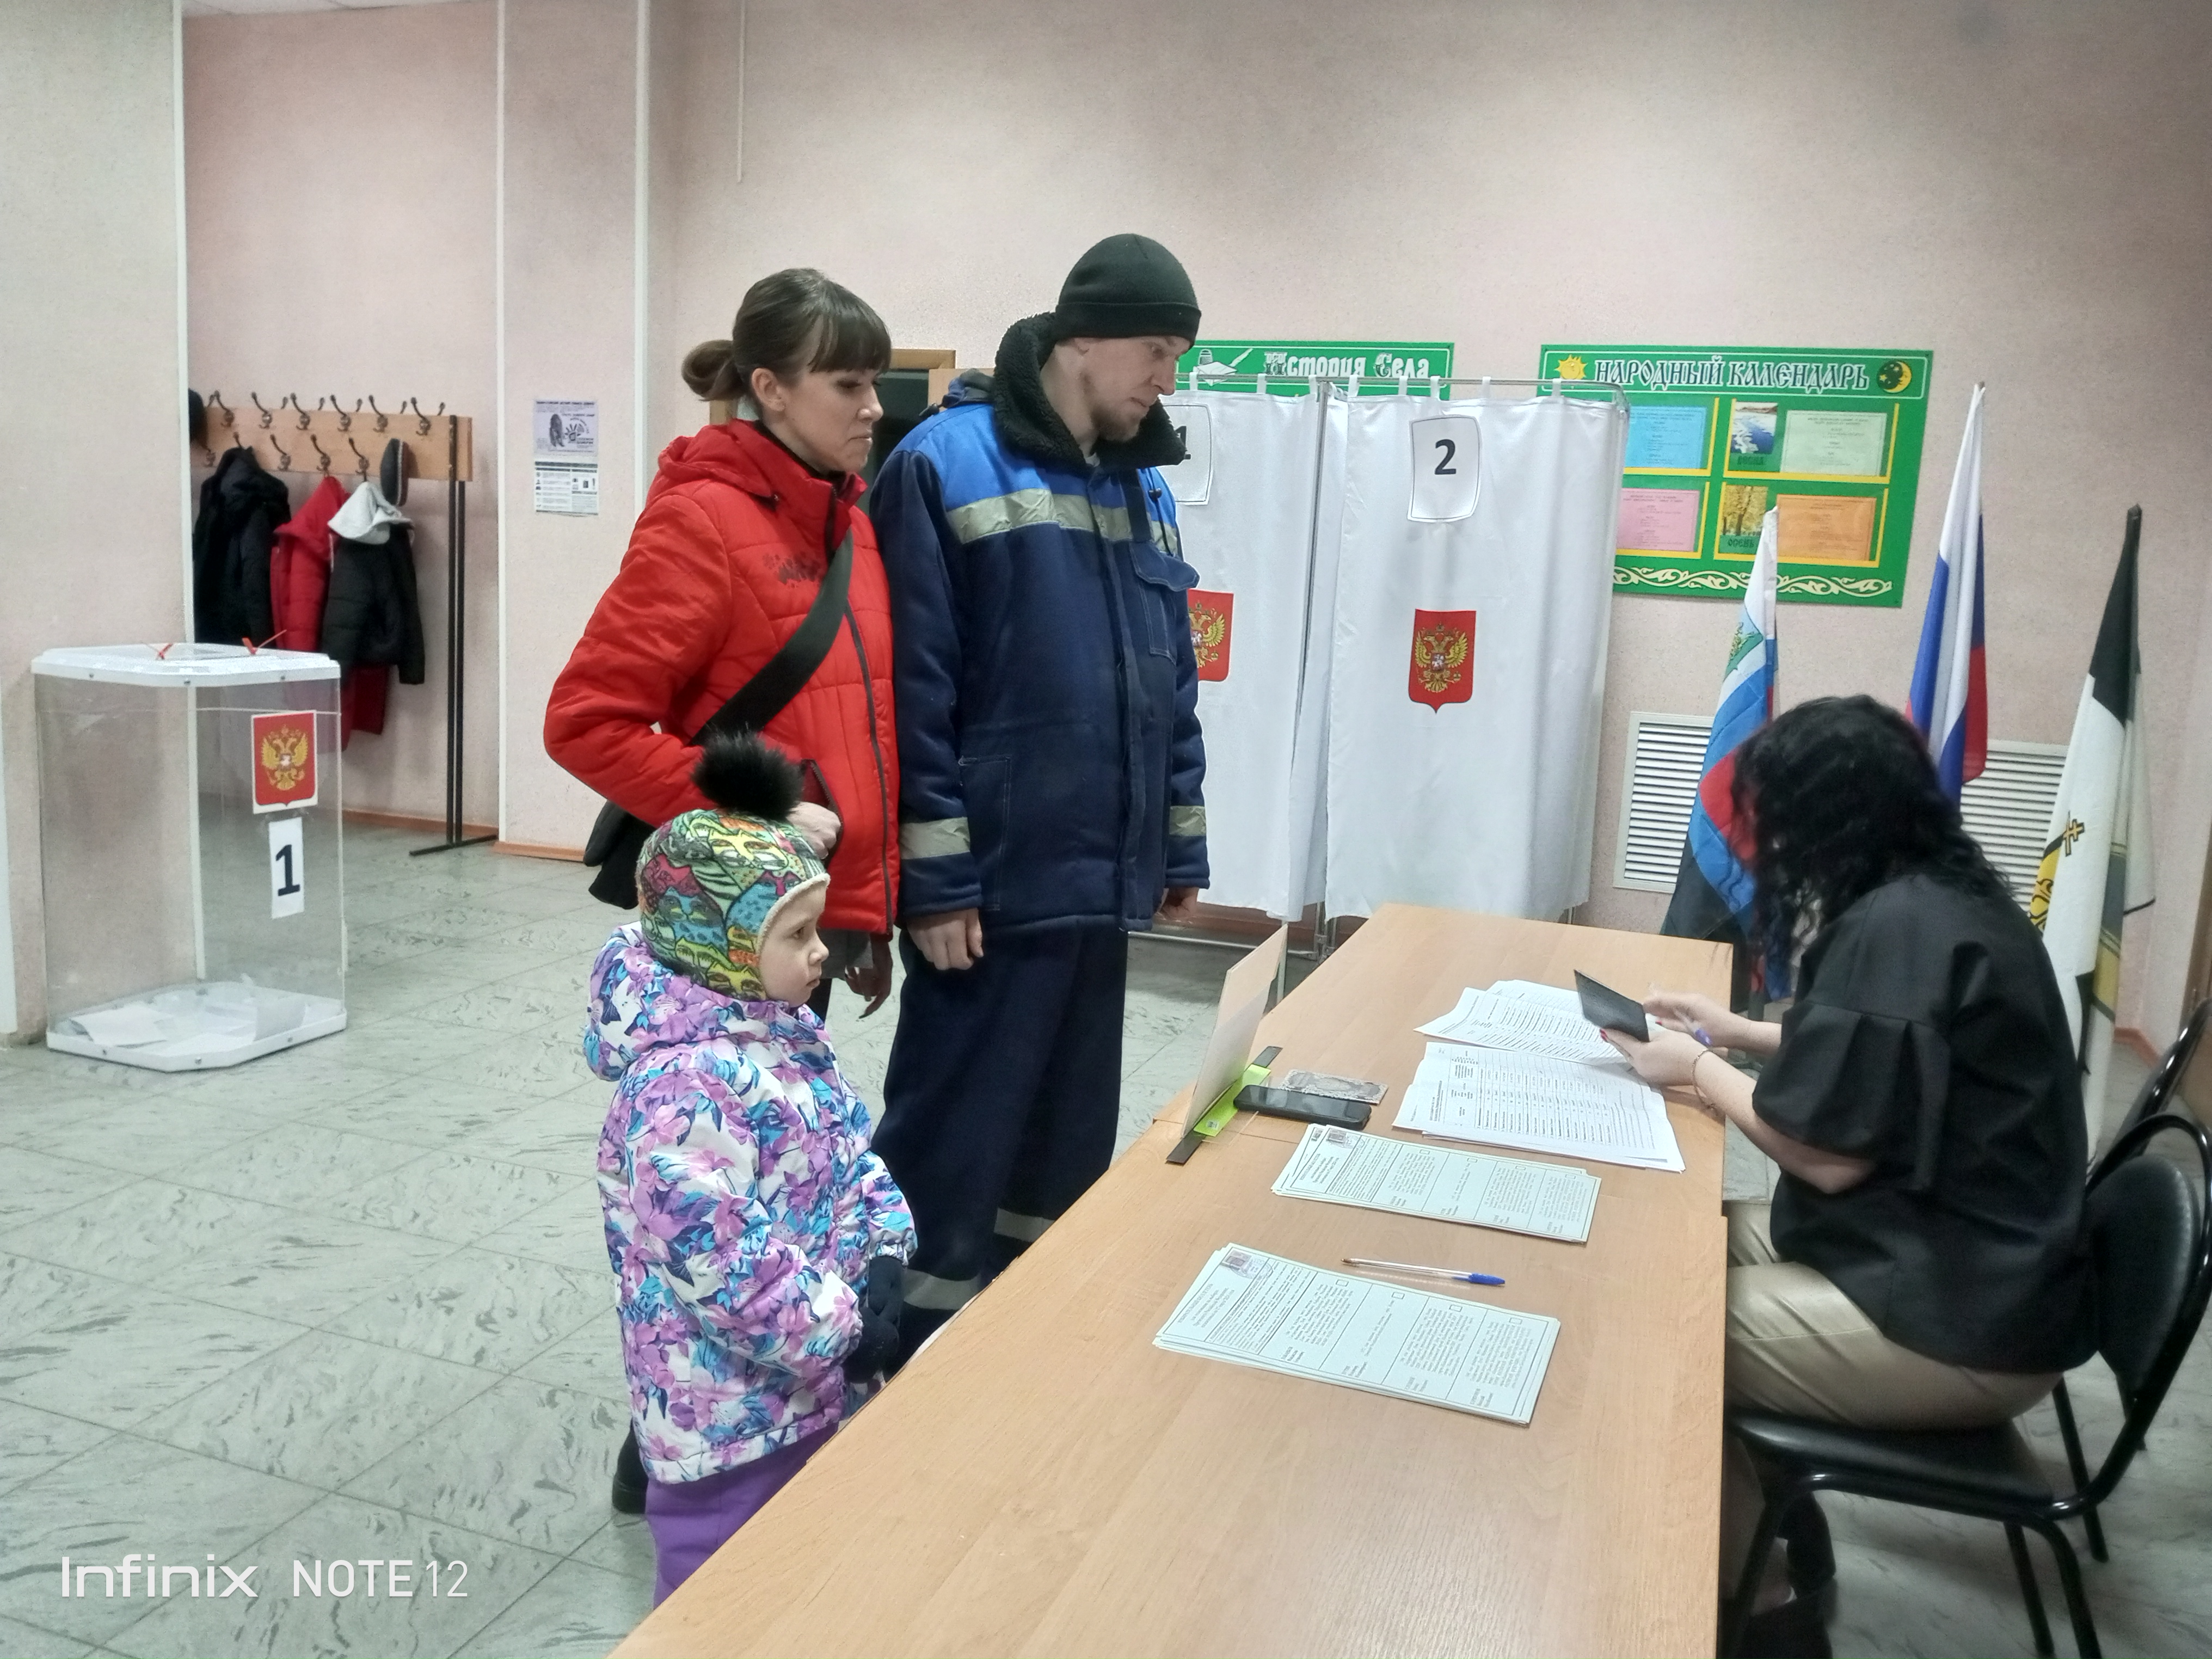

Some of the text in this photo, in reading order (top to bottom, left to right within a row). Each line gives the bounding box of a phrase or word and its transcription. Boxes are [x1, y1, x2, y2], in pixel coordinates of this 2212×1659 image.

[1374, 352, 1430, 378] Села
[1594, 355, 1869, 395] НАРОДНЫЙ КАЛЕНДАРЬ
[1434, 438, 1458, 476] 2
[275, 844, 300, 896] 1
